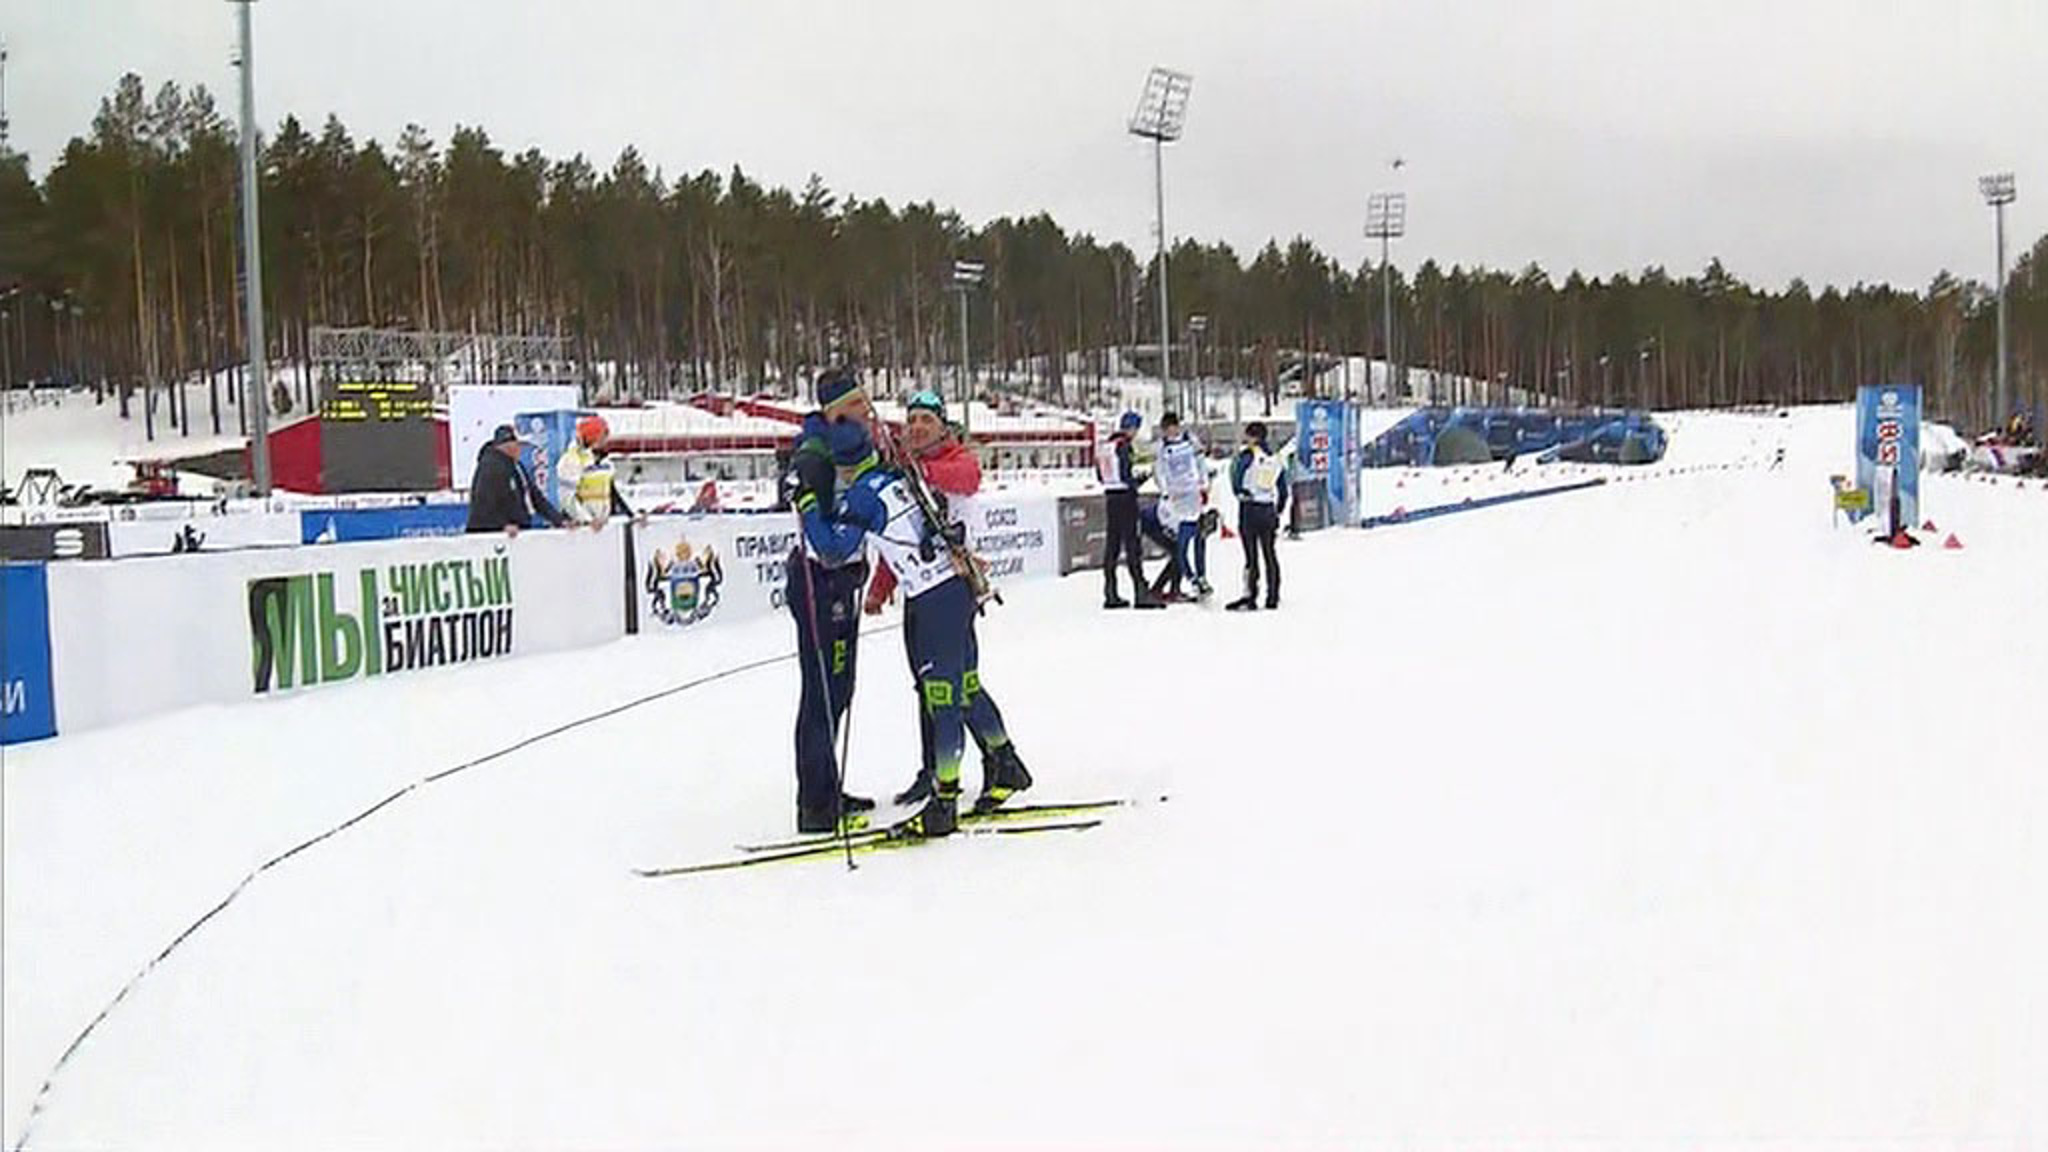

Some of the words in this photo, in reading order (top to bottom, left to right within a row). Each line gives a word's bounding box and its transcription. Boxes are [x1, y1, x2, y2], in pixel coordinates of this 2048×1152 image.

[389, 545, 513, 615] ЧИСТЫЙ
[249, 568, 382, 694] МЫ
[384, 608, 513, 673] БИАТЛОН
